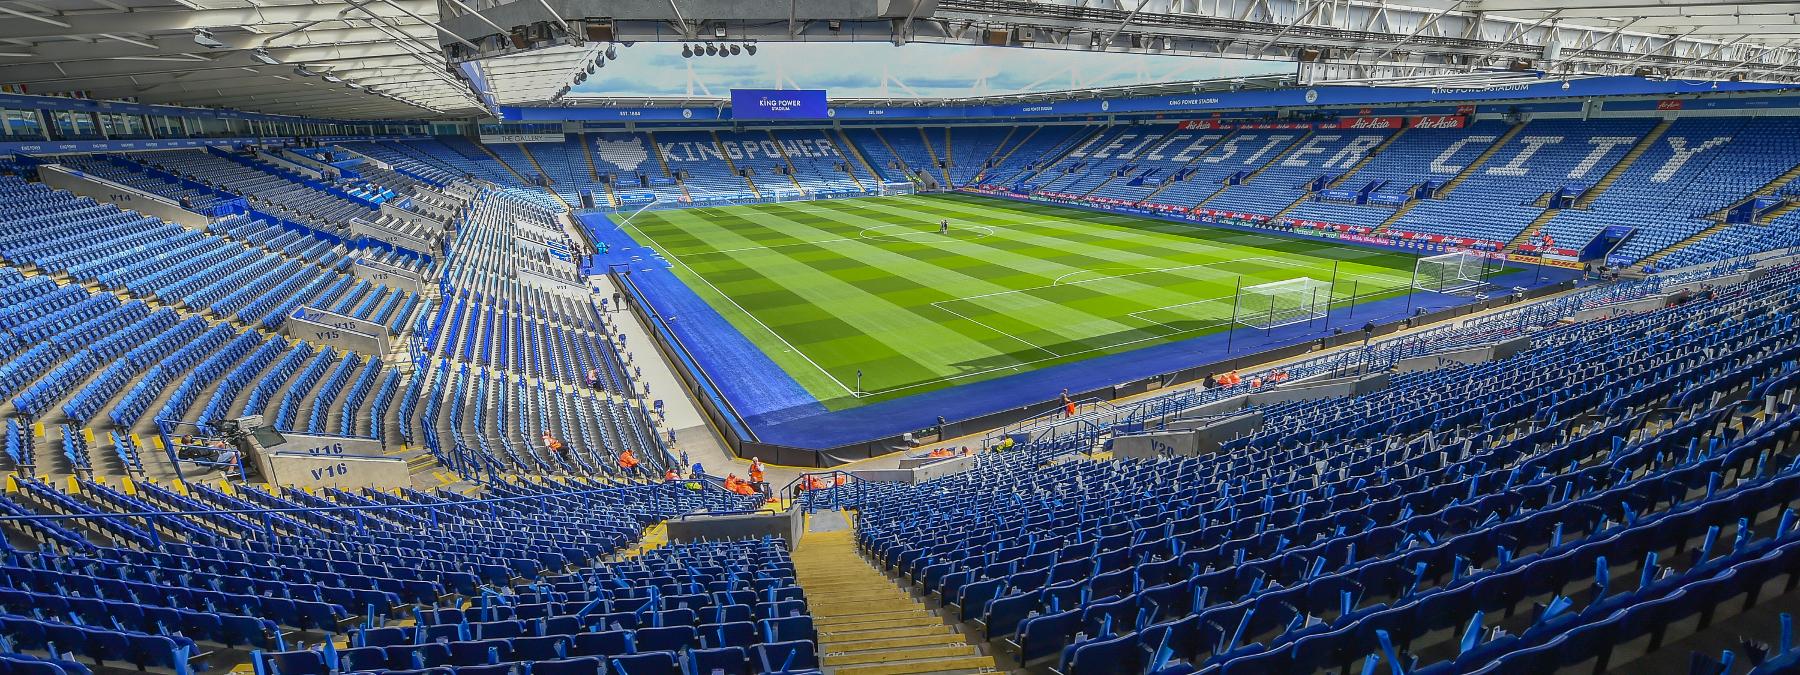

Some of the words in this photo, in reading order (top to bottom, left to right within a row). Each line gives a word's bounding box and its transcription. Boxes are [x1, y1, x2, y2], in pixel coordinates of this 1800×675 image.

[759, 99, 777, 107] KING
[514, 134, 543, 142] GALLERY
[1070, 134, 1383, 168] LEICESTER
[1431, 135, 1733, 183] CITY
[110, 193, 131, 203] V14
[316, 330, 339, 340] V15
[309, 442, 343, 456] V16
[311, 462, 348, 481] V16
